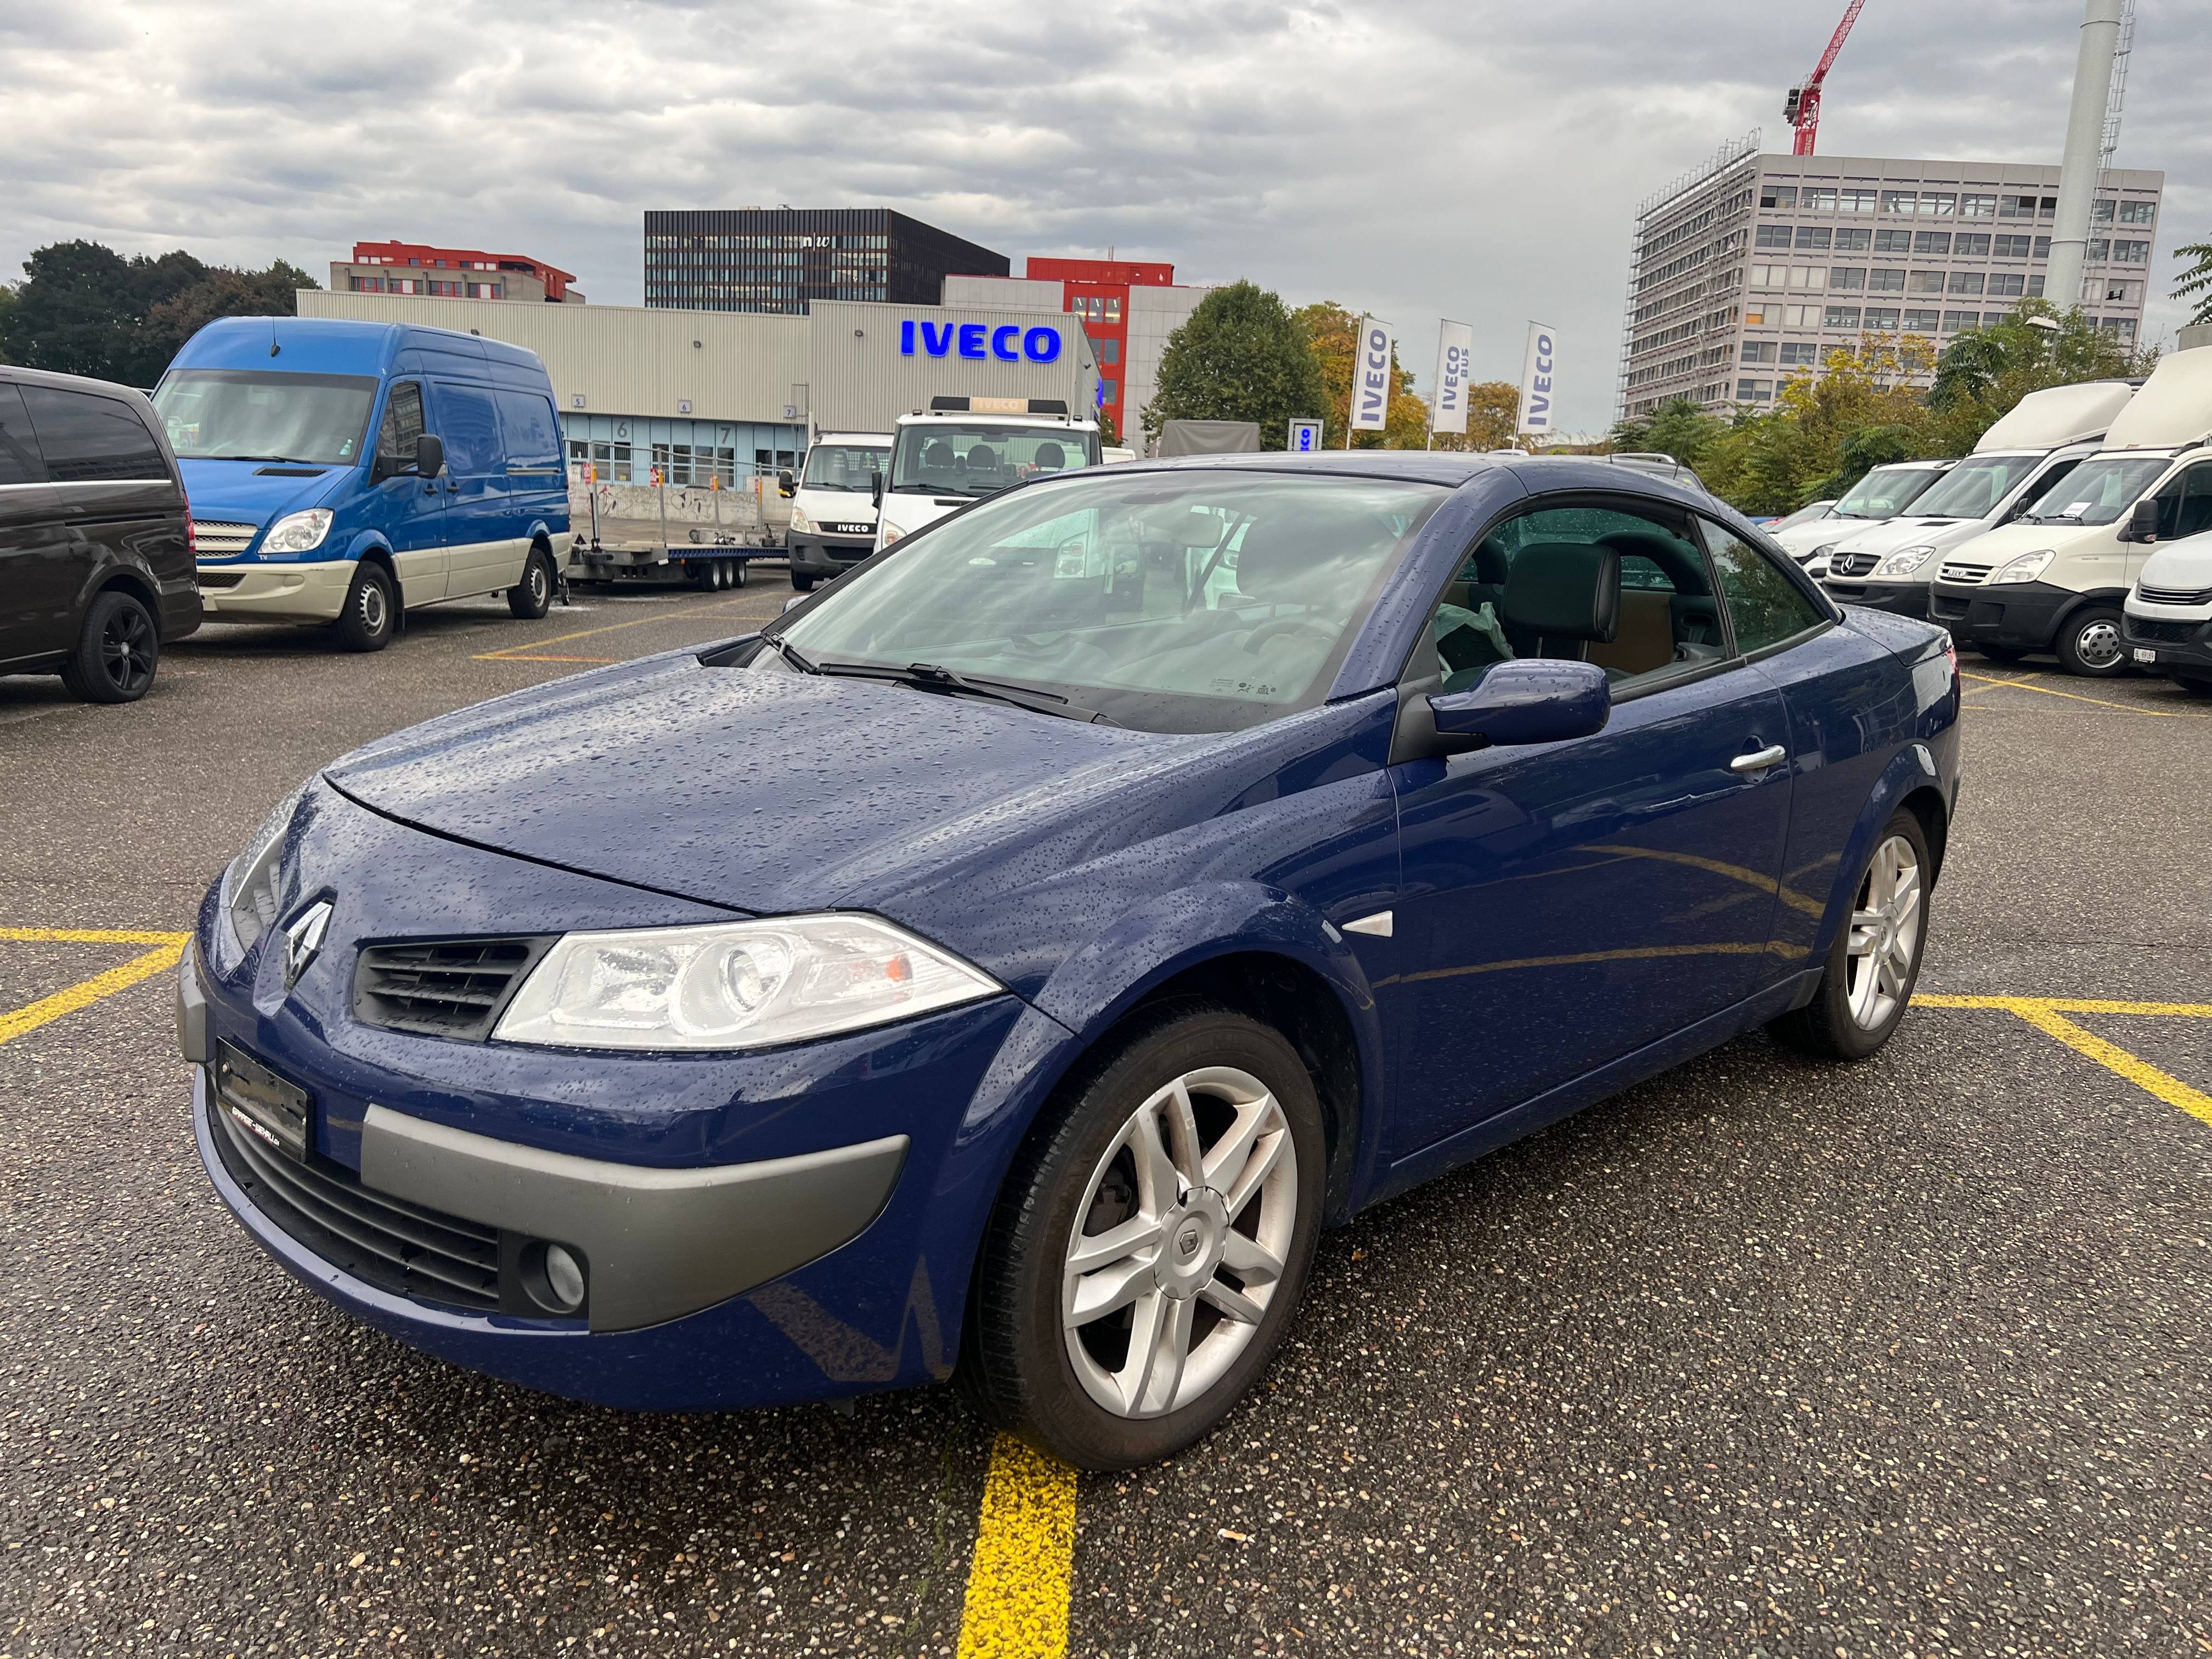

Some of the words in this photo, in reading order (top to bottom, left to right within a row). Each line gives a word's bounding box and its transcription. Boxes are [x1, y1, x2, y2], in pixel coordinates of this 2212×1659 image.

[901, 320, 1062, 363] IVECO
[1361, 329, 1386, 422] IVECO
[1461, 348, 1469, 377] BUS
[1442, 346, 1460, 410] IVECO
[1528, 334, 1553, 426] IVECO
[979, 399, 1019, 409] IVECO
[617, 421, 628, 438] 6
[720, 427, 731, 444] 7
[837, 524, 869, 532] IVECO
